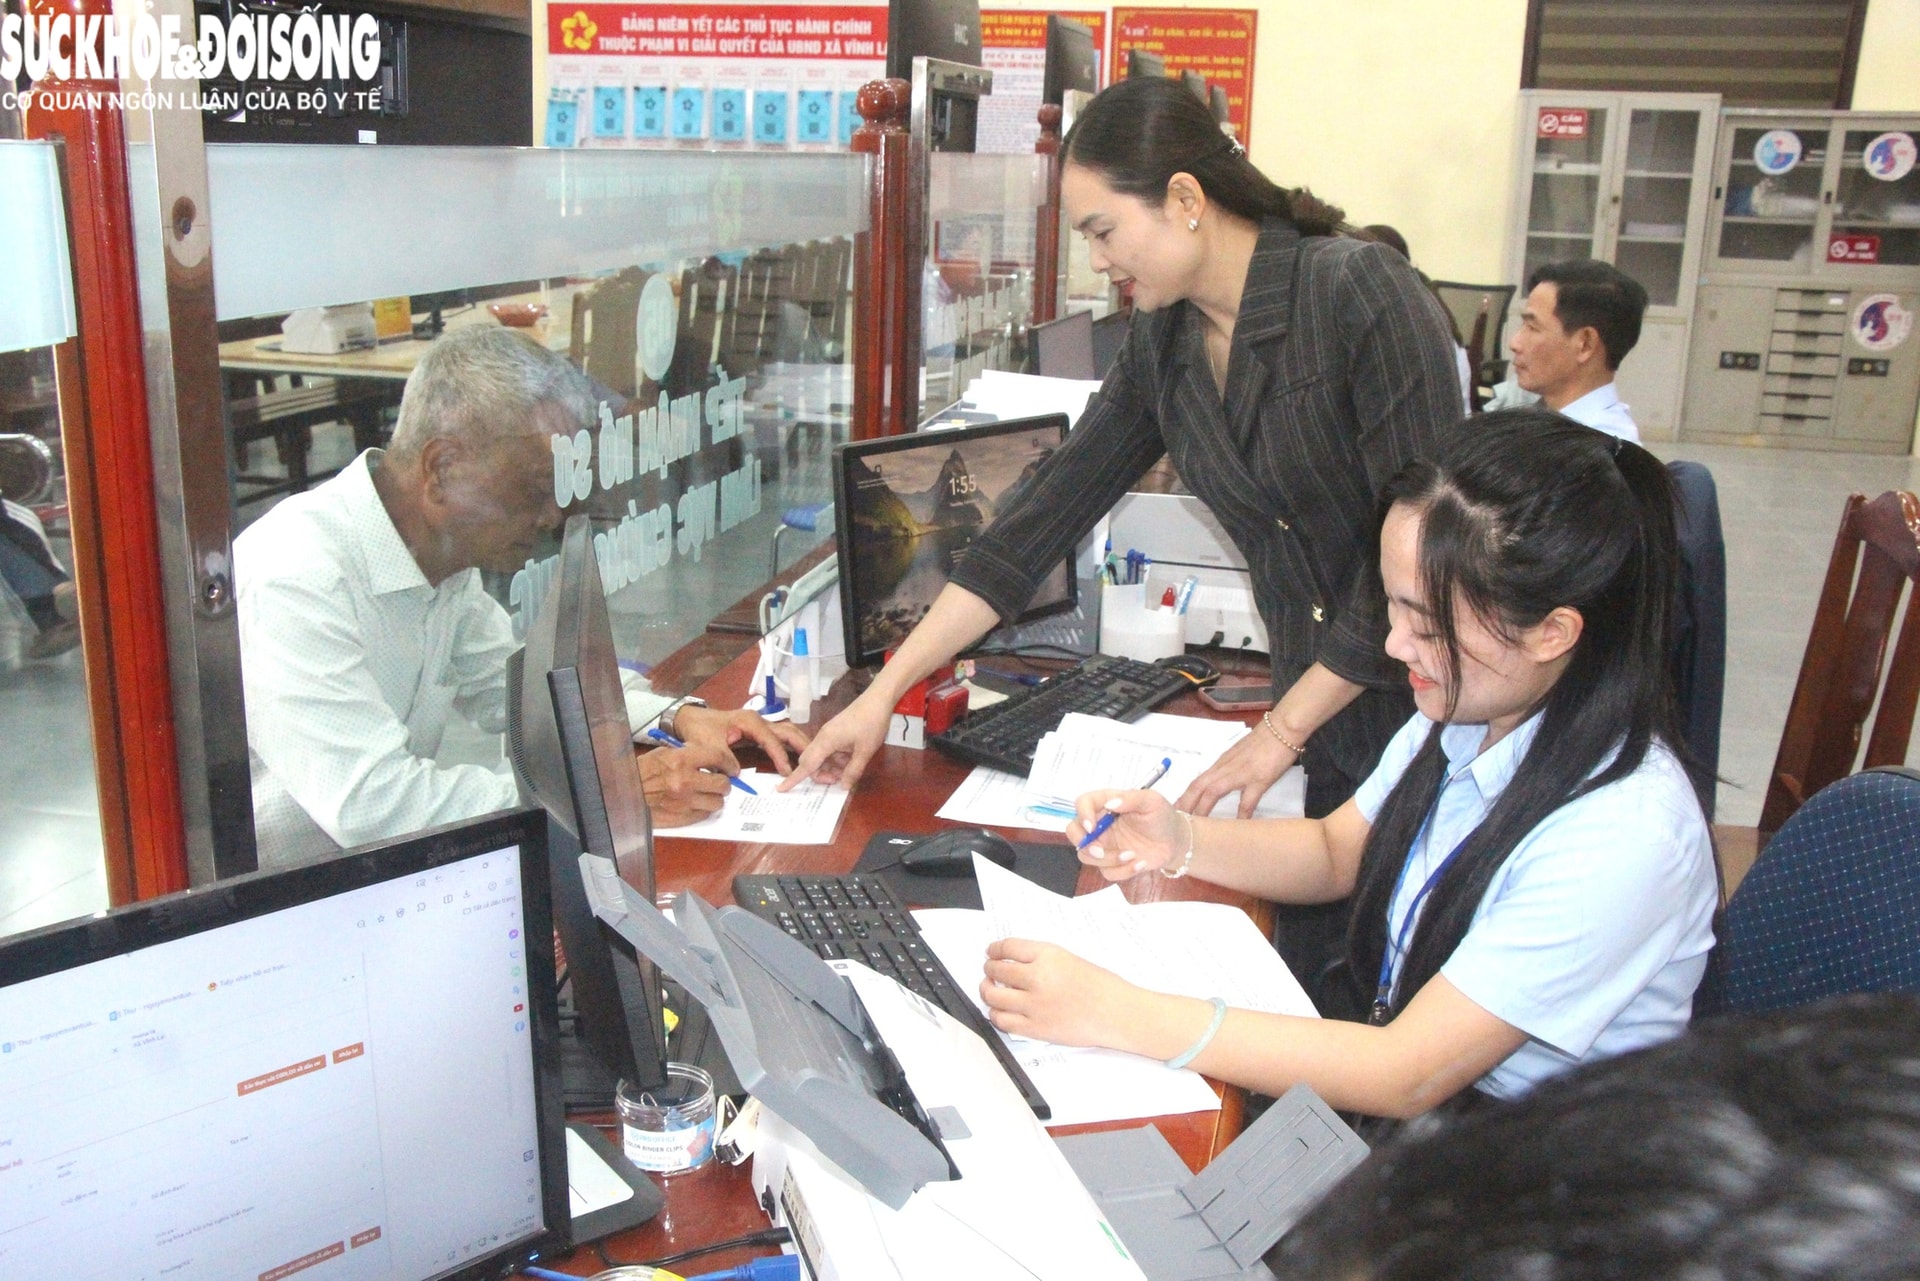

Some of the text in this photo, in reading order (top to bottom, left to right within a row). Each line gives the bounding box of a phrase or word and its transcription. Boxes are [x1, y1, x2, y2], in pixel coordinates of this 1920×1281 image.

[621, 12, 655, 32] BẢNG
[692, 14, 713, 33] YẾT
[716, 15, 741, 33] CÁC
[743, 14, 767, 33] THỦ
[770, 18, 794, 36] TỤC
[795, 17, 830, 35] HÀNH
[833, 18, 872, 36] CHÍNH
[599, 35, 638, 54] THUỘC
[640, 36, 675, 54] PHẠM
[677, 37, 690, 52] VI
[692, 33, 717, 53] GIẢI
[719, 34, 757, 54] QUYẾT
[759, 34, 785, 54] CỦA
[787, 39, 822, 54] UBND
[824, 38, 842, 55] XÃ
[844, 38, 874, 56] VĨNH
[949, 474, 977, 496] 1:55
